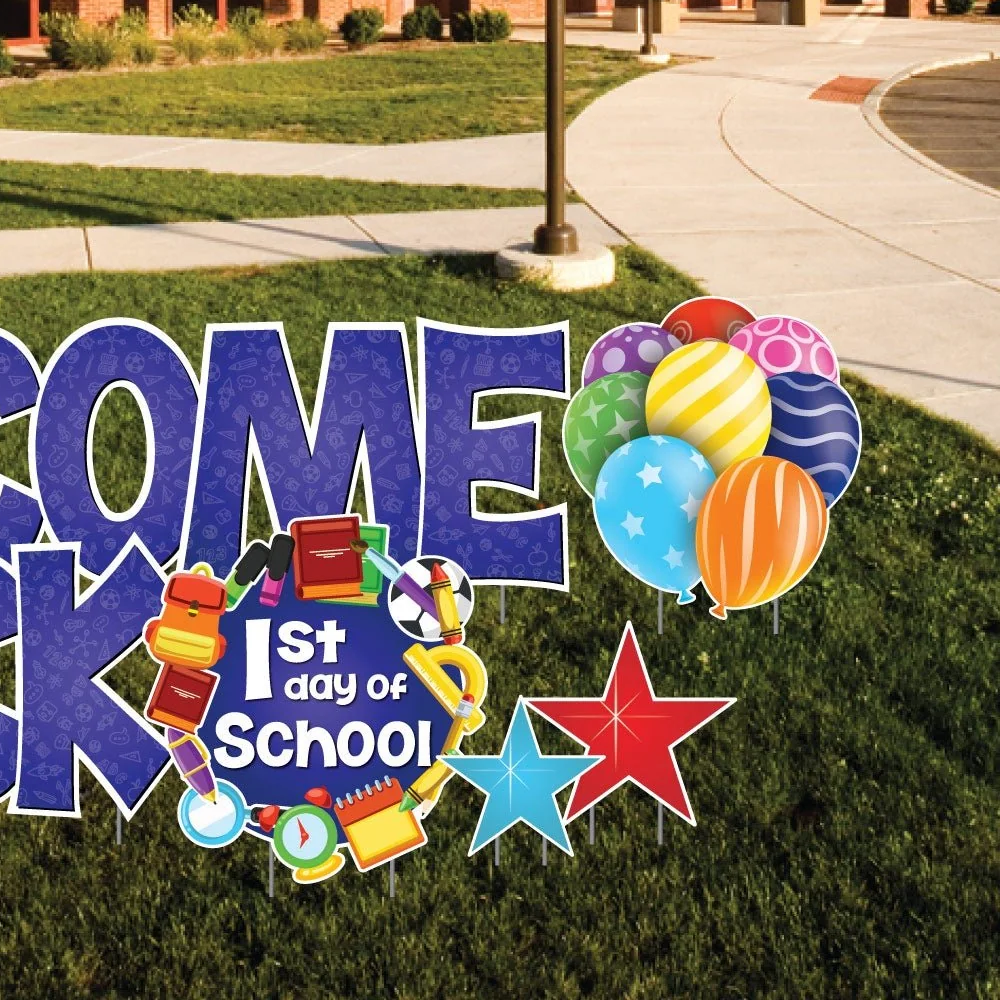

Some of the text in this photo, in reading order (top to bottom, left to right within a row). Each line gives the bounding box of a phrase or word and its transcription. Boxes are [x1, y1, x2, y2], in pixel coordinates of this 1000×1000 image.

[284, 673, 407, 706] day of
[213, 712, 433, 769] School
